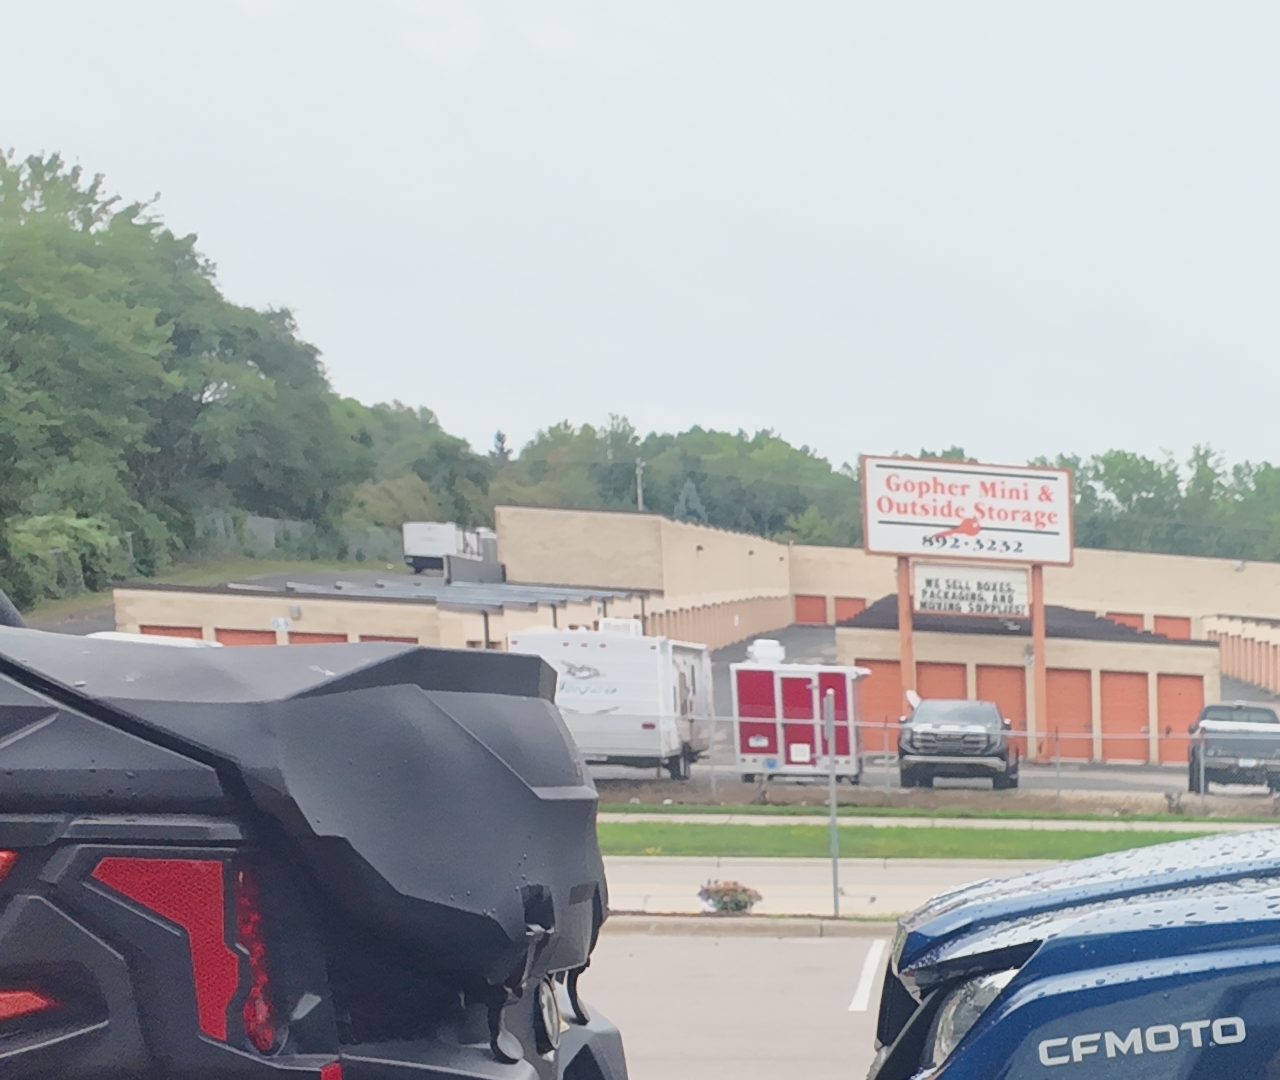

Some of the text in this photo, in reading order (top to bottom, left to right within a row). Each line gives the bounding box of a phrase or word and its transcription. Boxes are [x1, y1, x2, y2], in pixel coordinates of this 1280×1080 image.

[885, 473, 1054, 502] Gopher Mini &
[876, 495, 1058, 530] Outside Storage
[925, 578, 940, 589] WE
[945, 578, 971, 591] SELL
[920, 601, 962, 611] MOVING
[992, 594, 1014, 604] AND
[1038, 1016, 1247, 1067] CFMOTO
